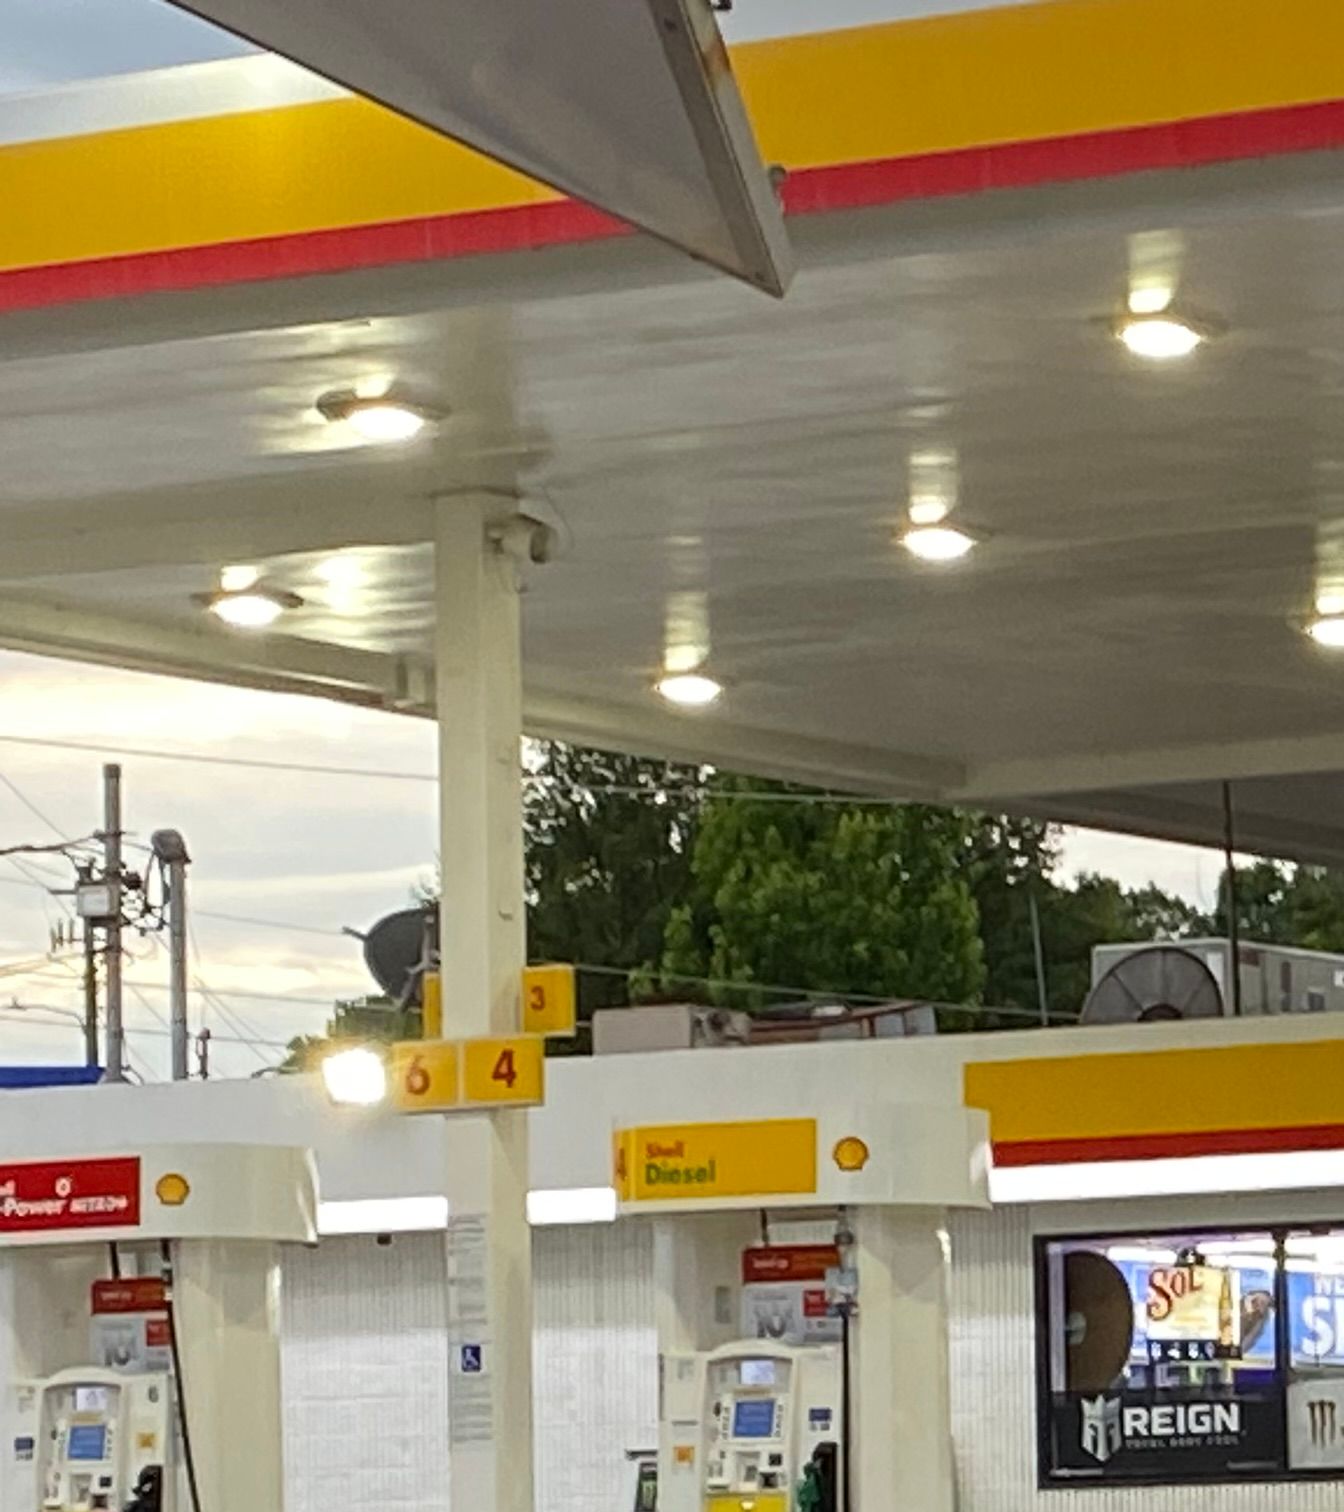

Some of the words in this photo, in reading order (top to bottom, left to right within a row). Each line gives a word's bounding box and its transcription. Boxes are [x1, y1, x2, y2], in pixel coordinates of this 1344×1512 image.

[531, 985, 546, 1011] 3
[405, 1054, 431, 1095] 6
[491, 1048, 517, 1088] 4
[646, 1140, 684, 1159] Shell
[645, 1159, 717, 1186] Diesel
[1122, 1402, 1241, 1437] REIGN
